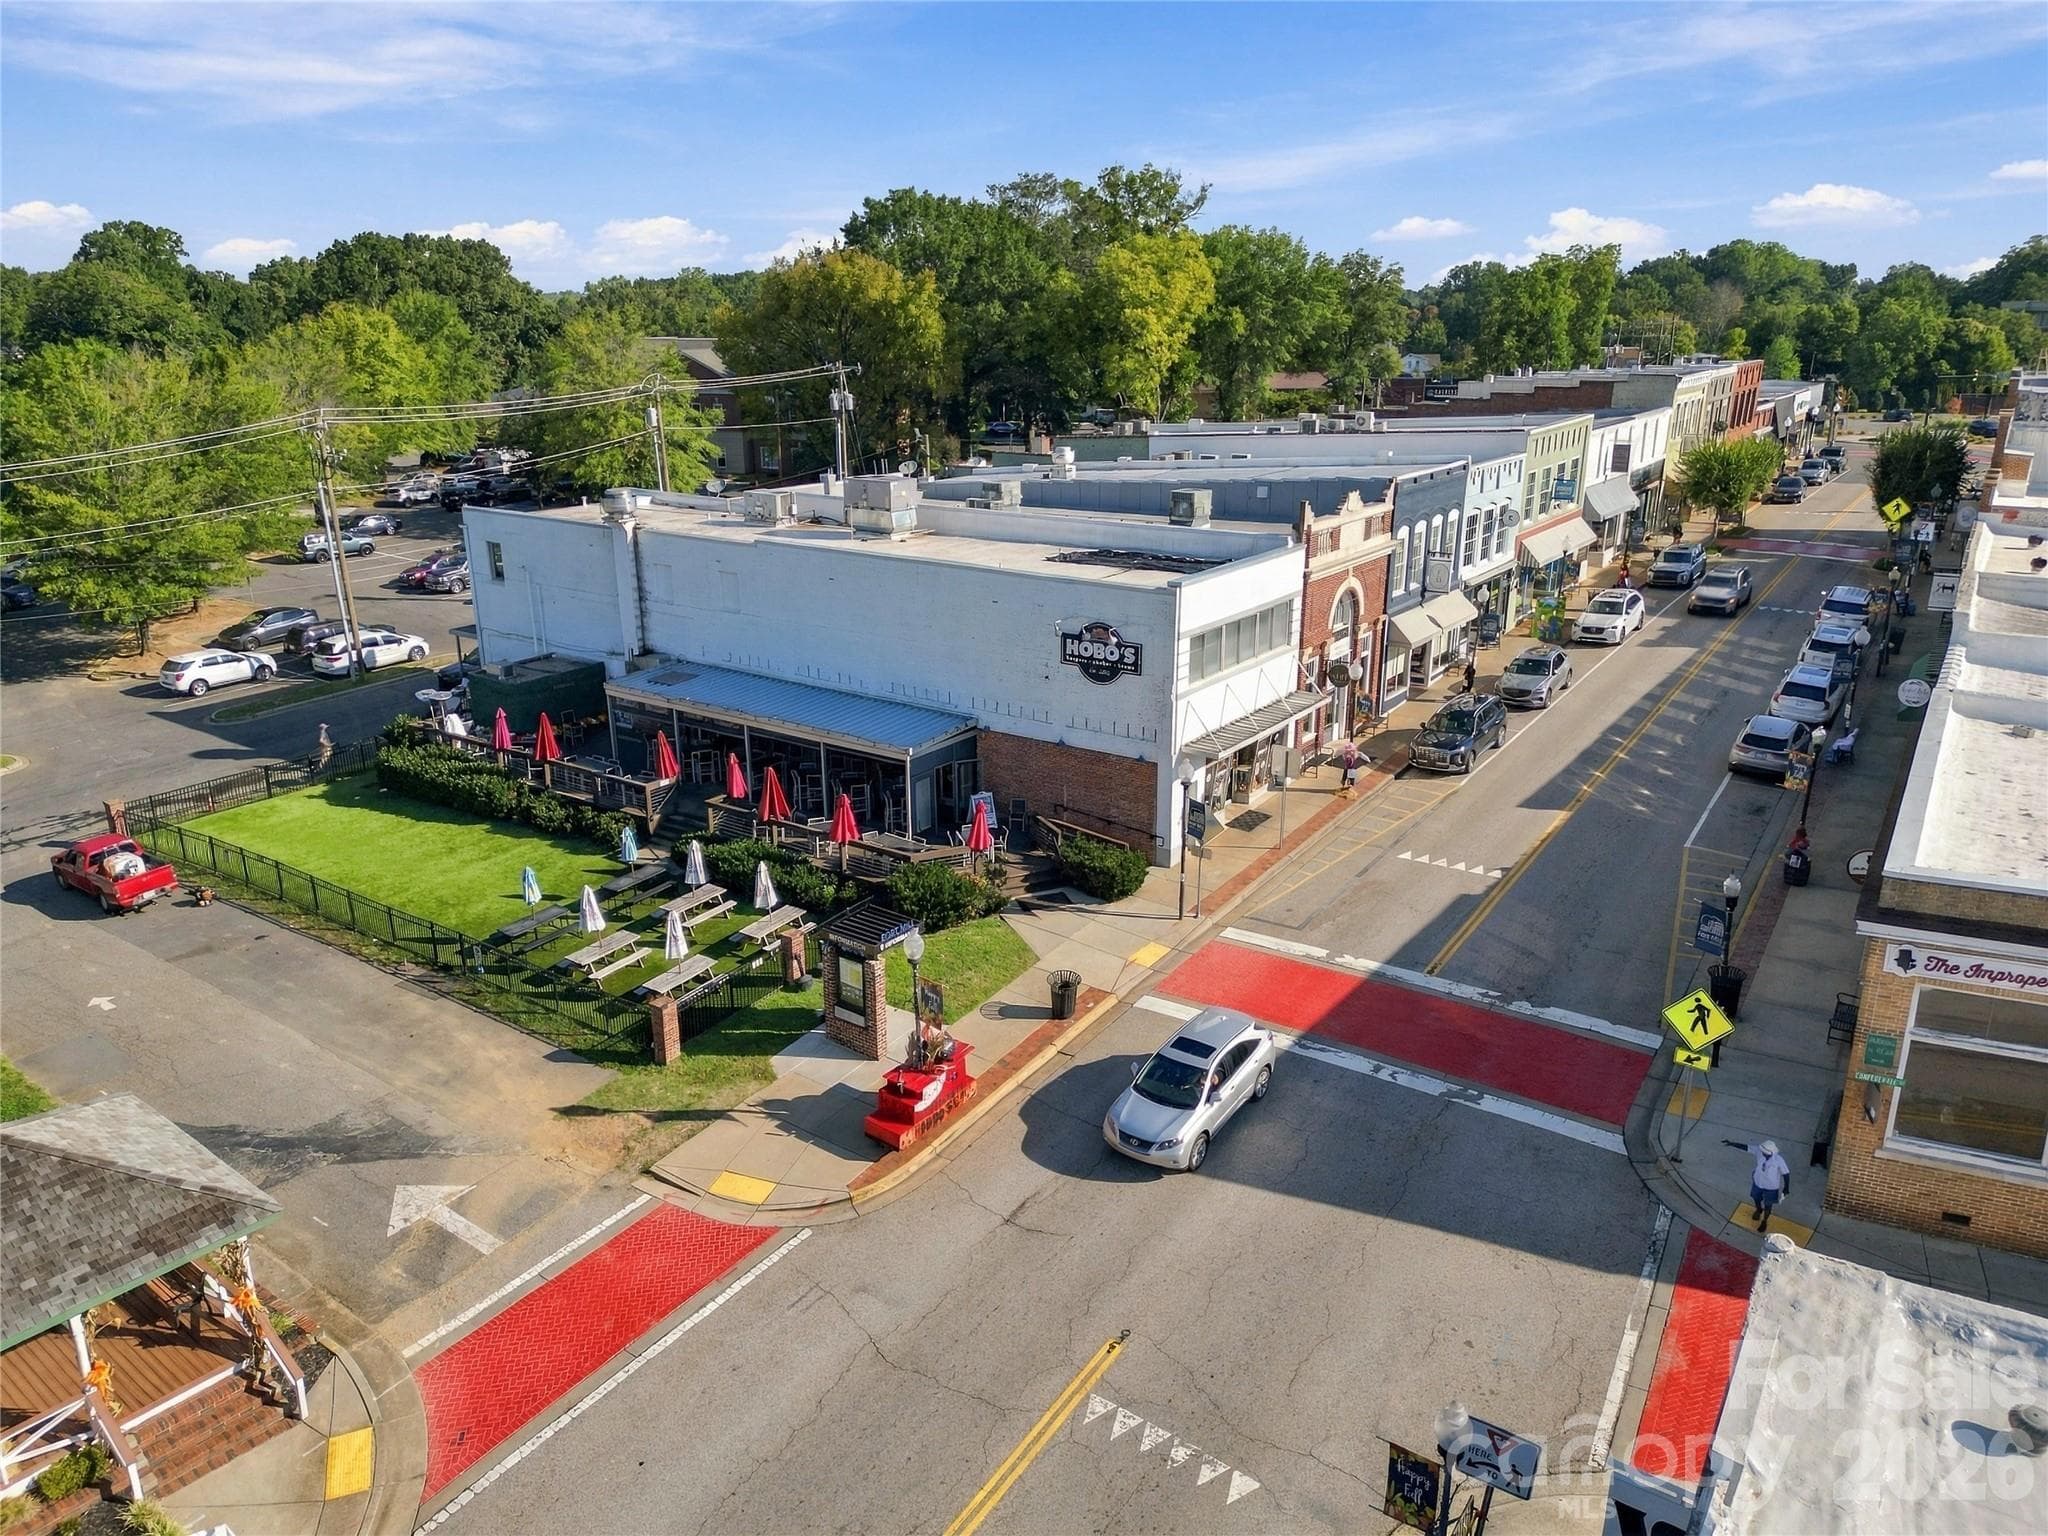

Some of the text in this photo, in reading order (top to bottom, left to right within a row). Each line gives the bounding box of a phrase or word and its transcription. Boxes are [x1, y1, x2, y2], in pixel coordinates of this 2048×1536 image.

[1066, 639, 1135, 664] HOBO'S
[1924, 955, 2048, 989] The Imprope
[1468, 1446, 1493, 1462] HERE
[1487, 1469, 1499, 1481] TO
